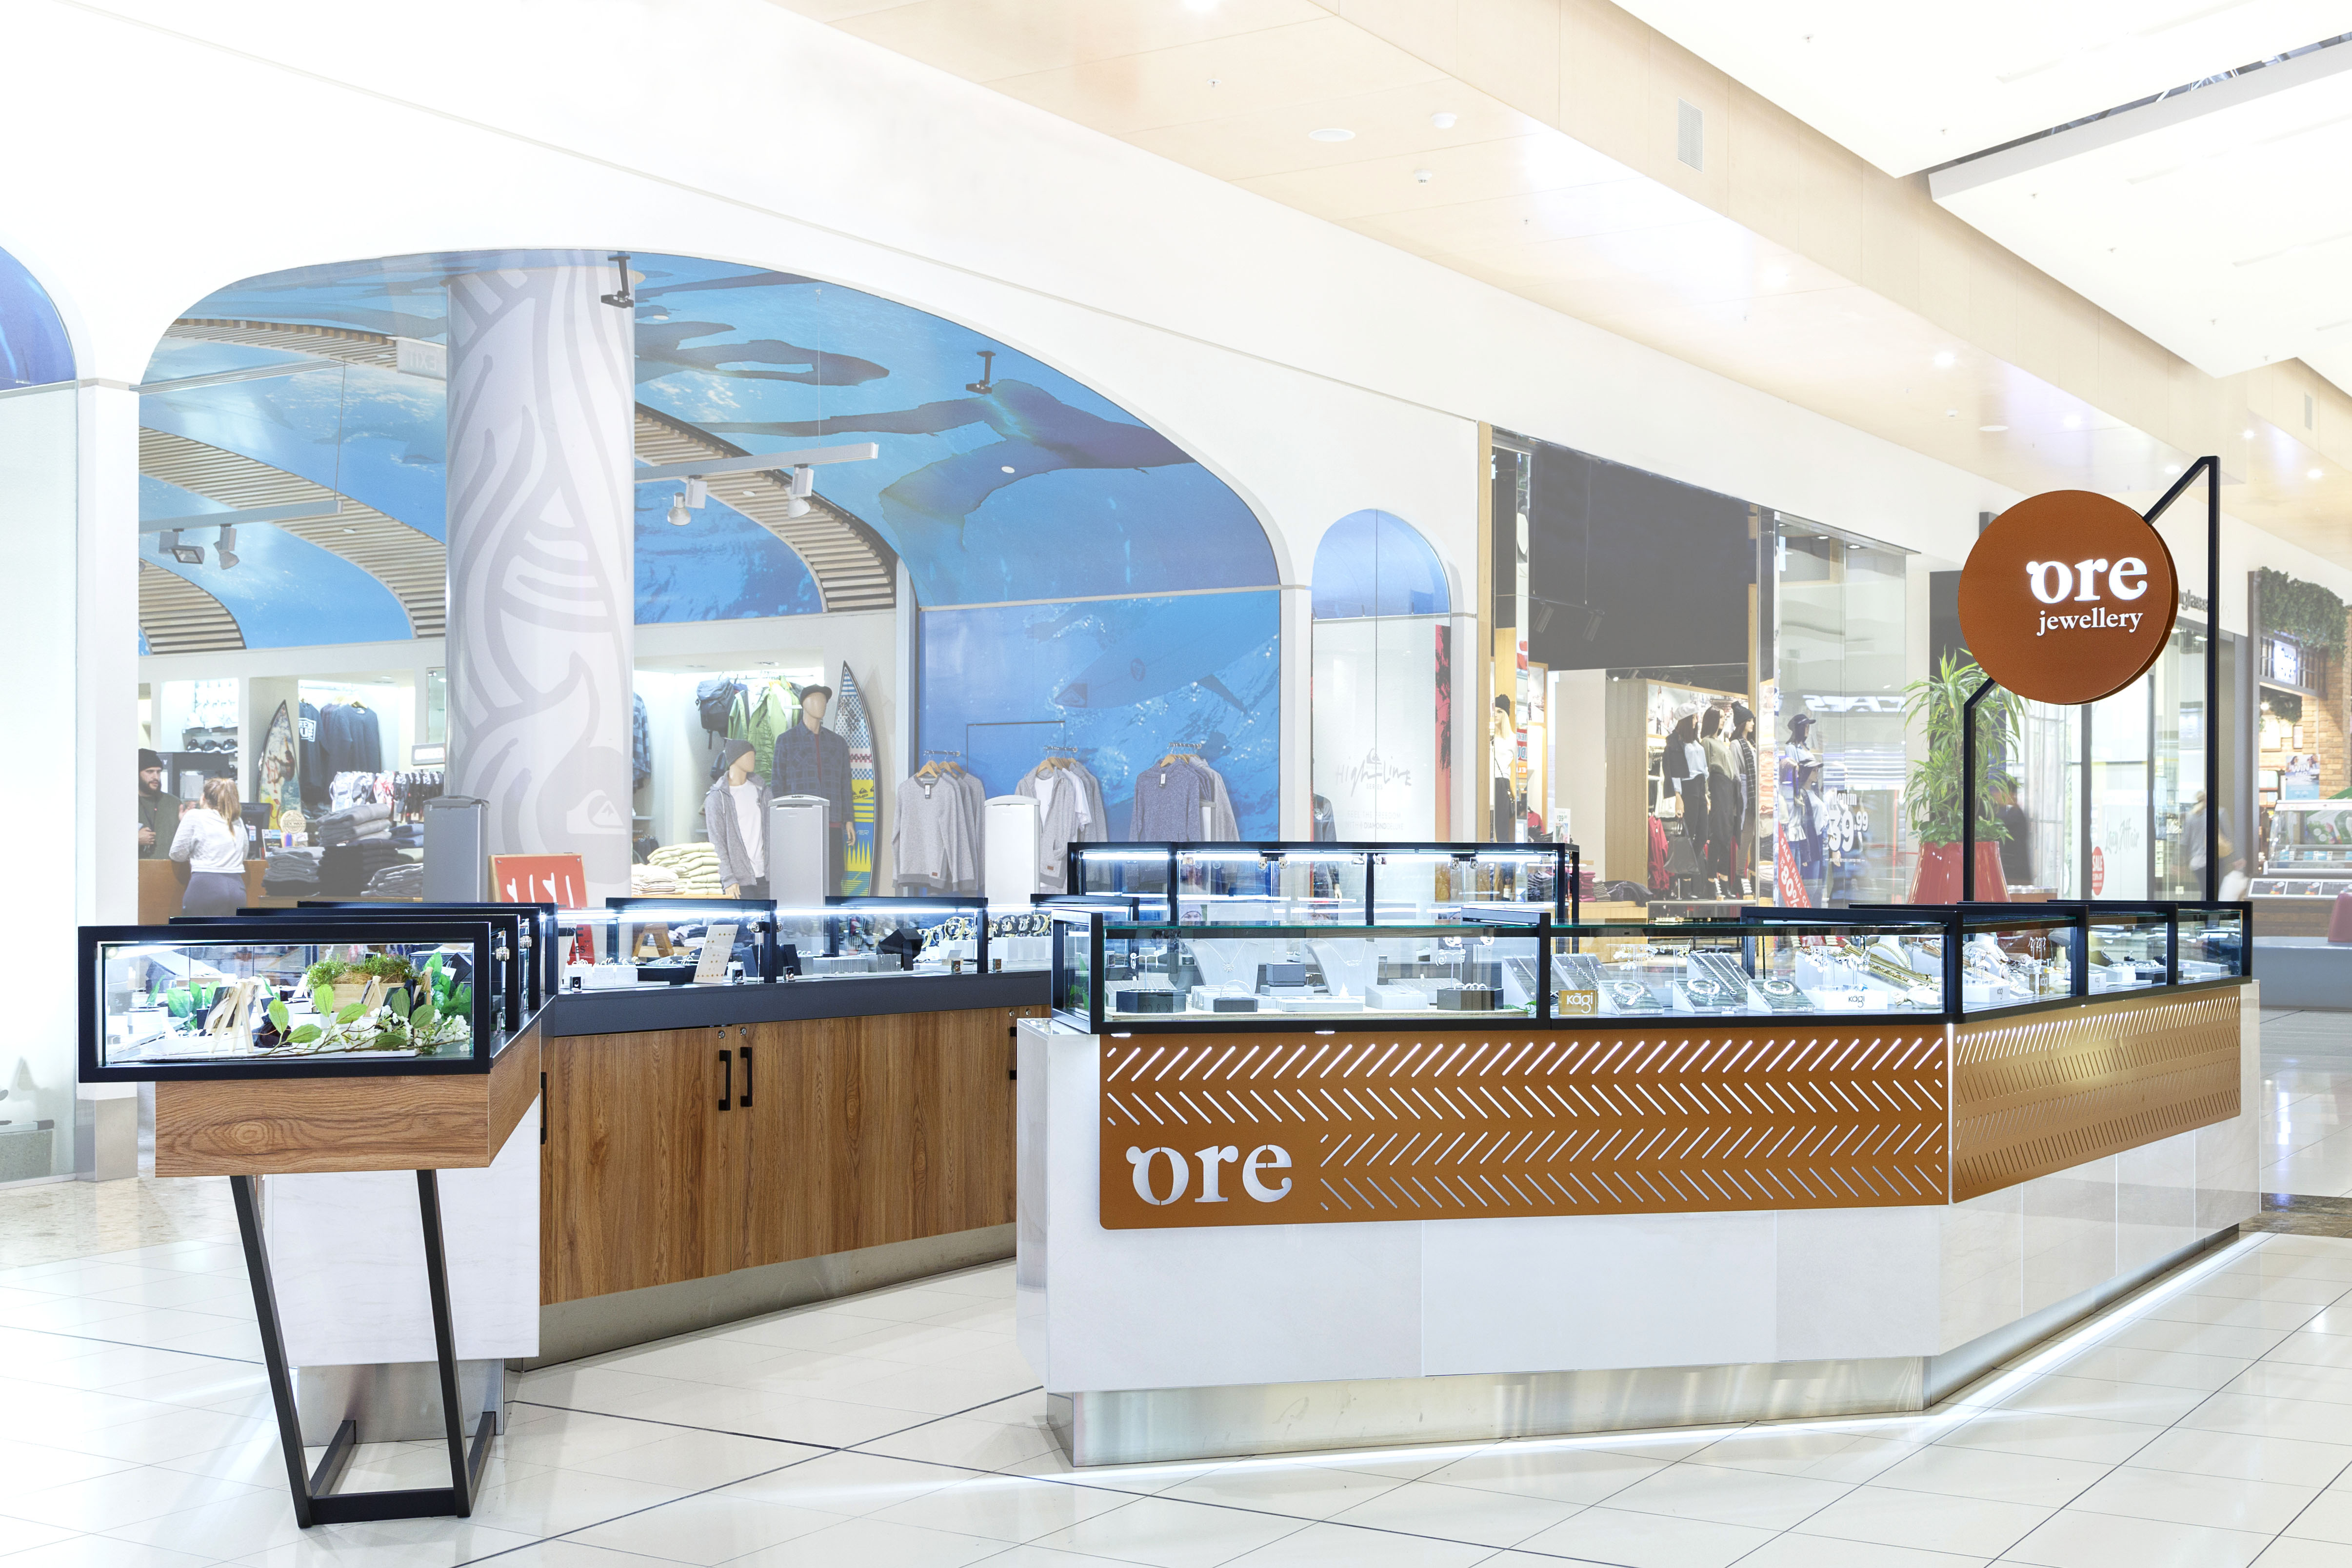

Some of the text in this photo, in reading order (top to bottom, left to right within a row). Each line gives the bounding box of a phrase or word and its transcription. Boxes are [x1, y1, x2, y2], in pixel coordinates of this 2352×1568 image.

[2026, 557, 2147, 604] ore
[2036, 607, 2143, 636] jewellery
[2292, 764, 2310, 773] WIN
[1780, 838, 1791, 862] SALE
[1792, 867, 1802, 895] FINAL
[2093, 855, 2103, 872] SALE
[1126, 1144, 1292, 1205] ore
